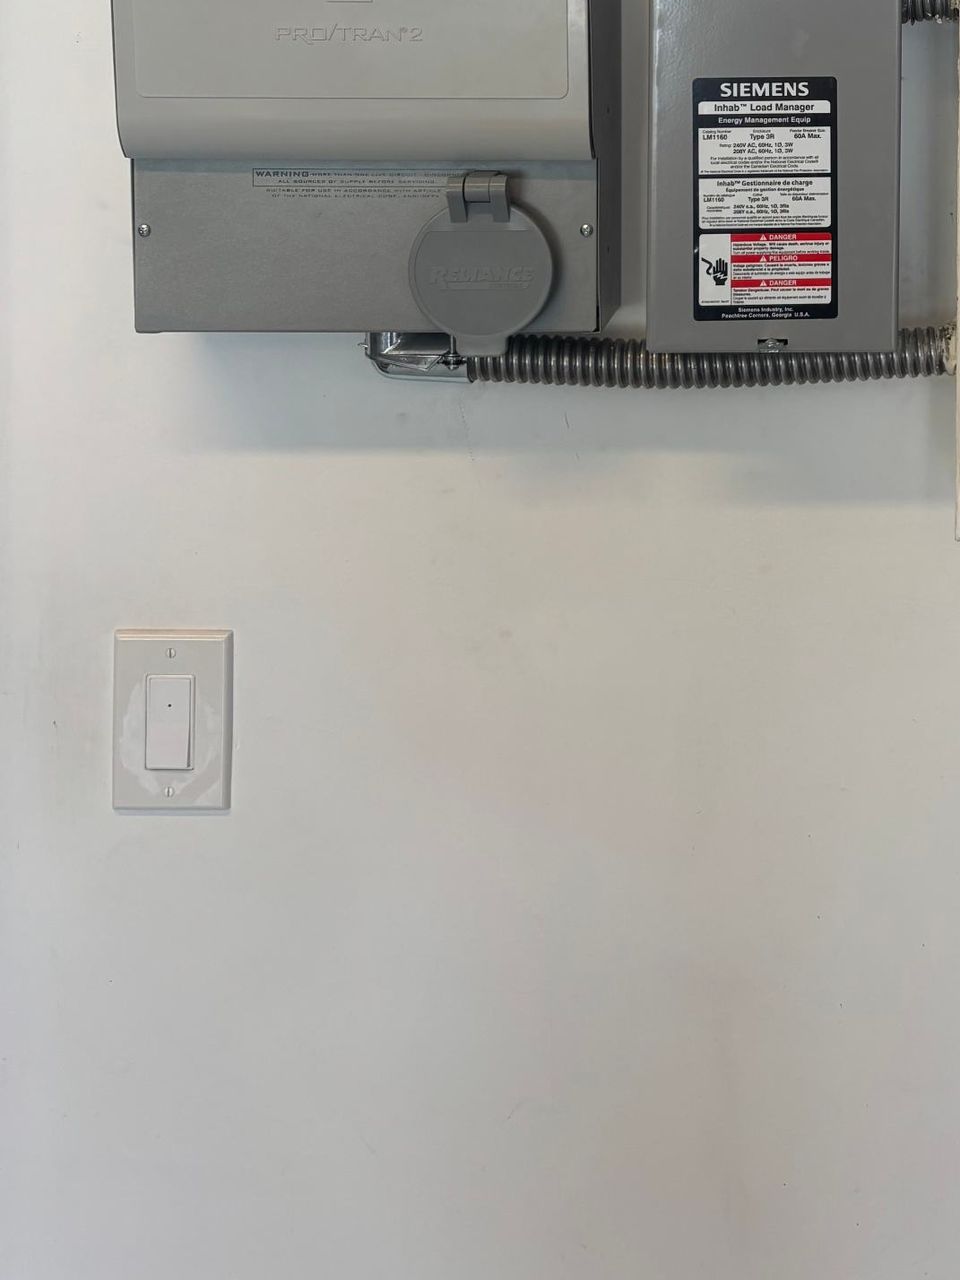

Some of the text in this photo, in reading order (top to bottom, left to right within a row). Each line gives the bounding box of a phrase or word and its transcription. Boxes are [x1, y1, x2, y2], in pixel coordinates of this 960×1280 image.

[720, 82, 809, 98] SIEMENS
[750, 104, 773, 112] Load
[775, 104, 815, 112] Manager
[718, 116, 812, 124] Energy Management Equip
